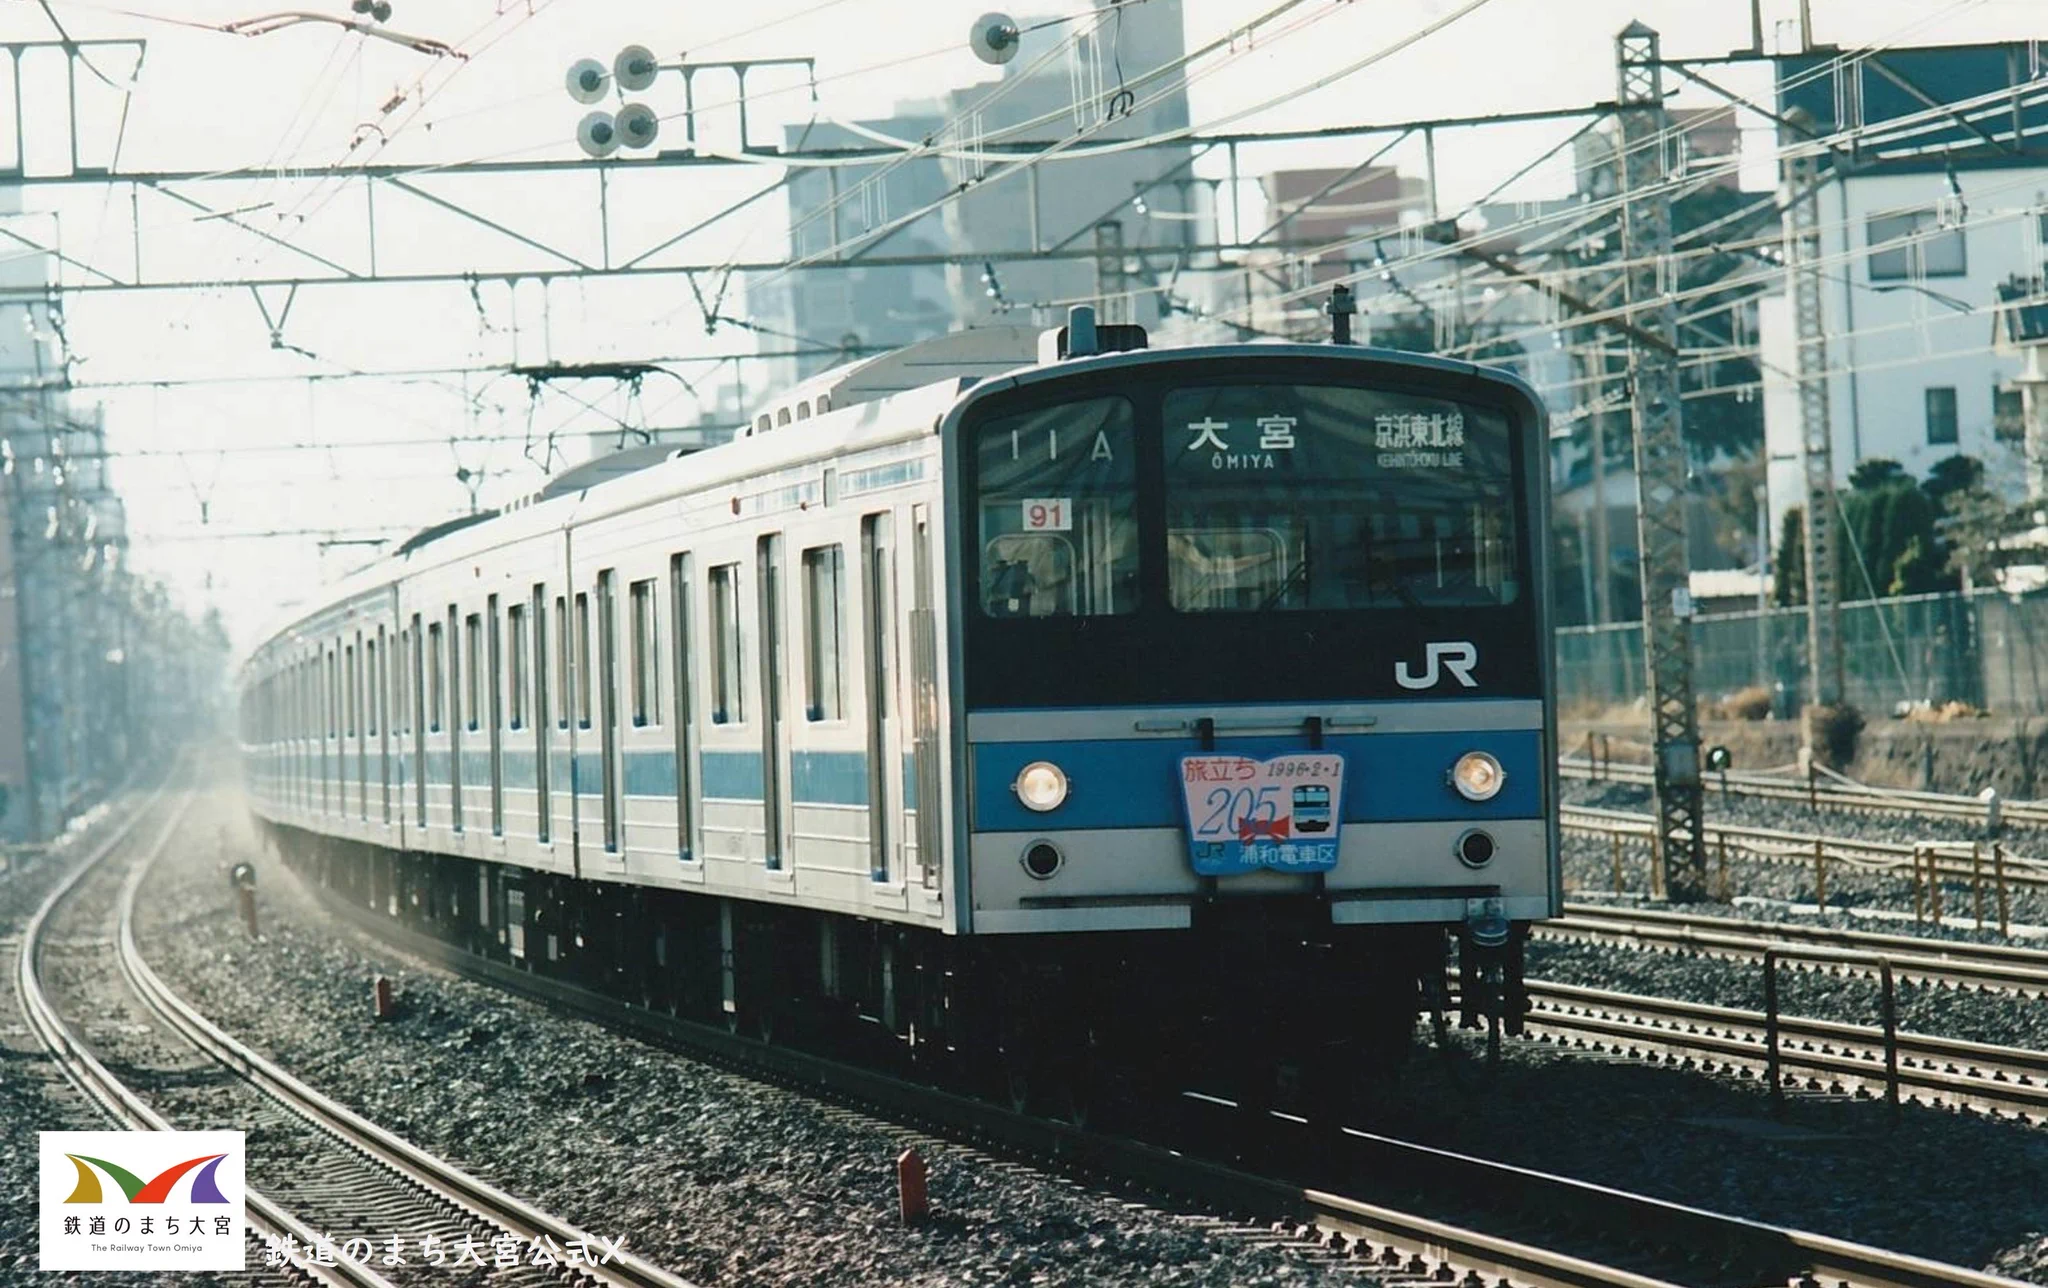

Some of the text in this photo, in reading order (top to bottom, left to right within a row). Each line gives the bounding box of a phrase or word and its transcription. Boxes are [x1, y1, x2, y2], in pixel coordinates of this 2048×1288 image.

[1188, 414, 1298, 450] 大宮
[1374, 413, 1465, 449] 京浜東北線
[1029, 504, 1062, 528] 91
[1394, 641, 1479, 690] JR
[1184, 758, 1256, 782] 旅立ち
[1197, 786, 1281, 835] 205
[1196, 842, 1225, 858] JR
[1239, 843, 1336, 865] 浦和電車区
